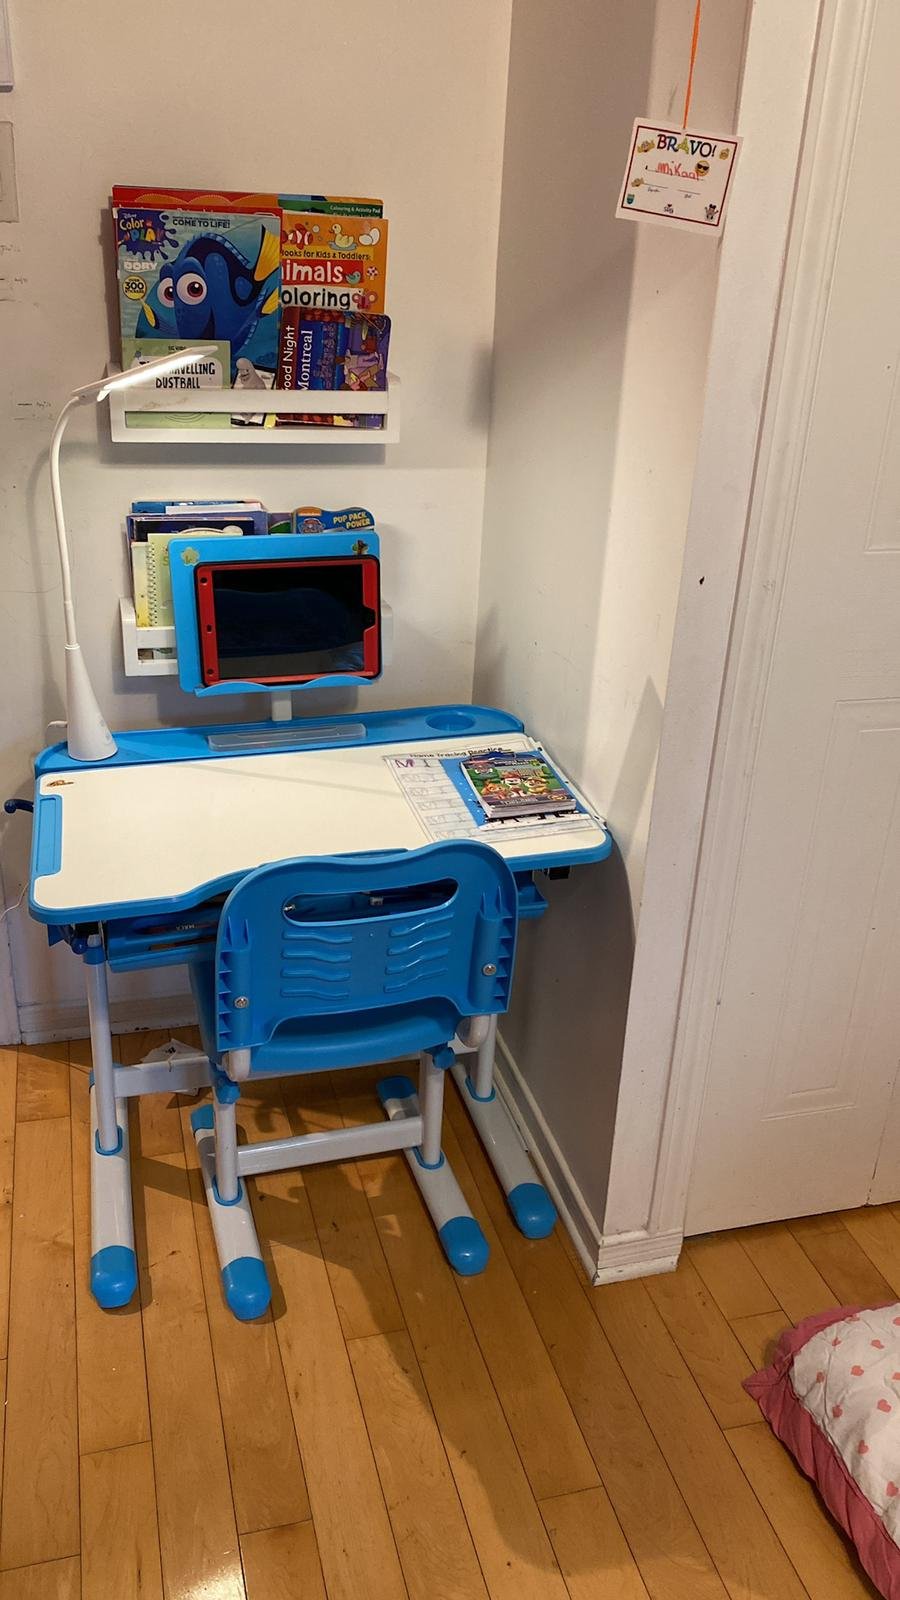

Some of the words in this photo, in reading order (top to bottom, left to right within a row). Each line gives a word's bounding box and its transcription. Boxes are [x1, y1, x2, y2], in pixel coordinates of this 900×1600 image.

[656, 134, 717, 157] BRAVO!
[120, 218, 144, 230] Color
[172, 219, 197, 227] COME
[197, 220, 209, 228] TO
[210, 220, 230, 229] LIFE!
[123, 261, 158, 271] DORY
[281, 259, 343, 283] imals
[125, 281, 144, 291] 300
[283, 325, 297, 362] Night
[155, 376, 200, 389] DUSTBALL
[282, 365, 293, 390] ood
[348, 512, 367, 521] PACK
[346, 518, 371, 529] POWER
